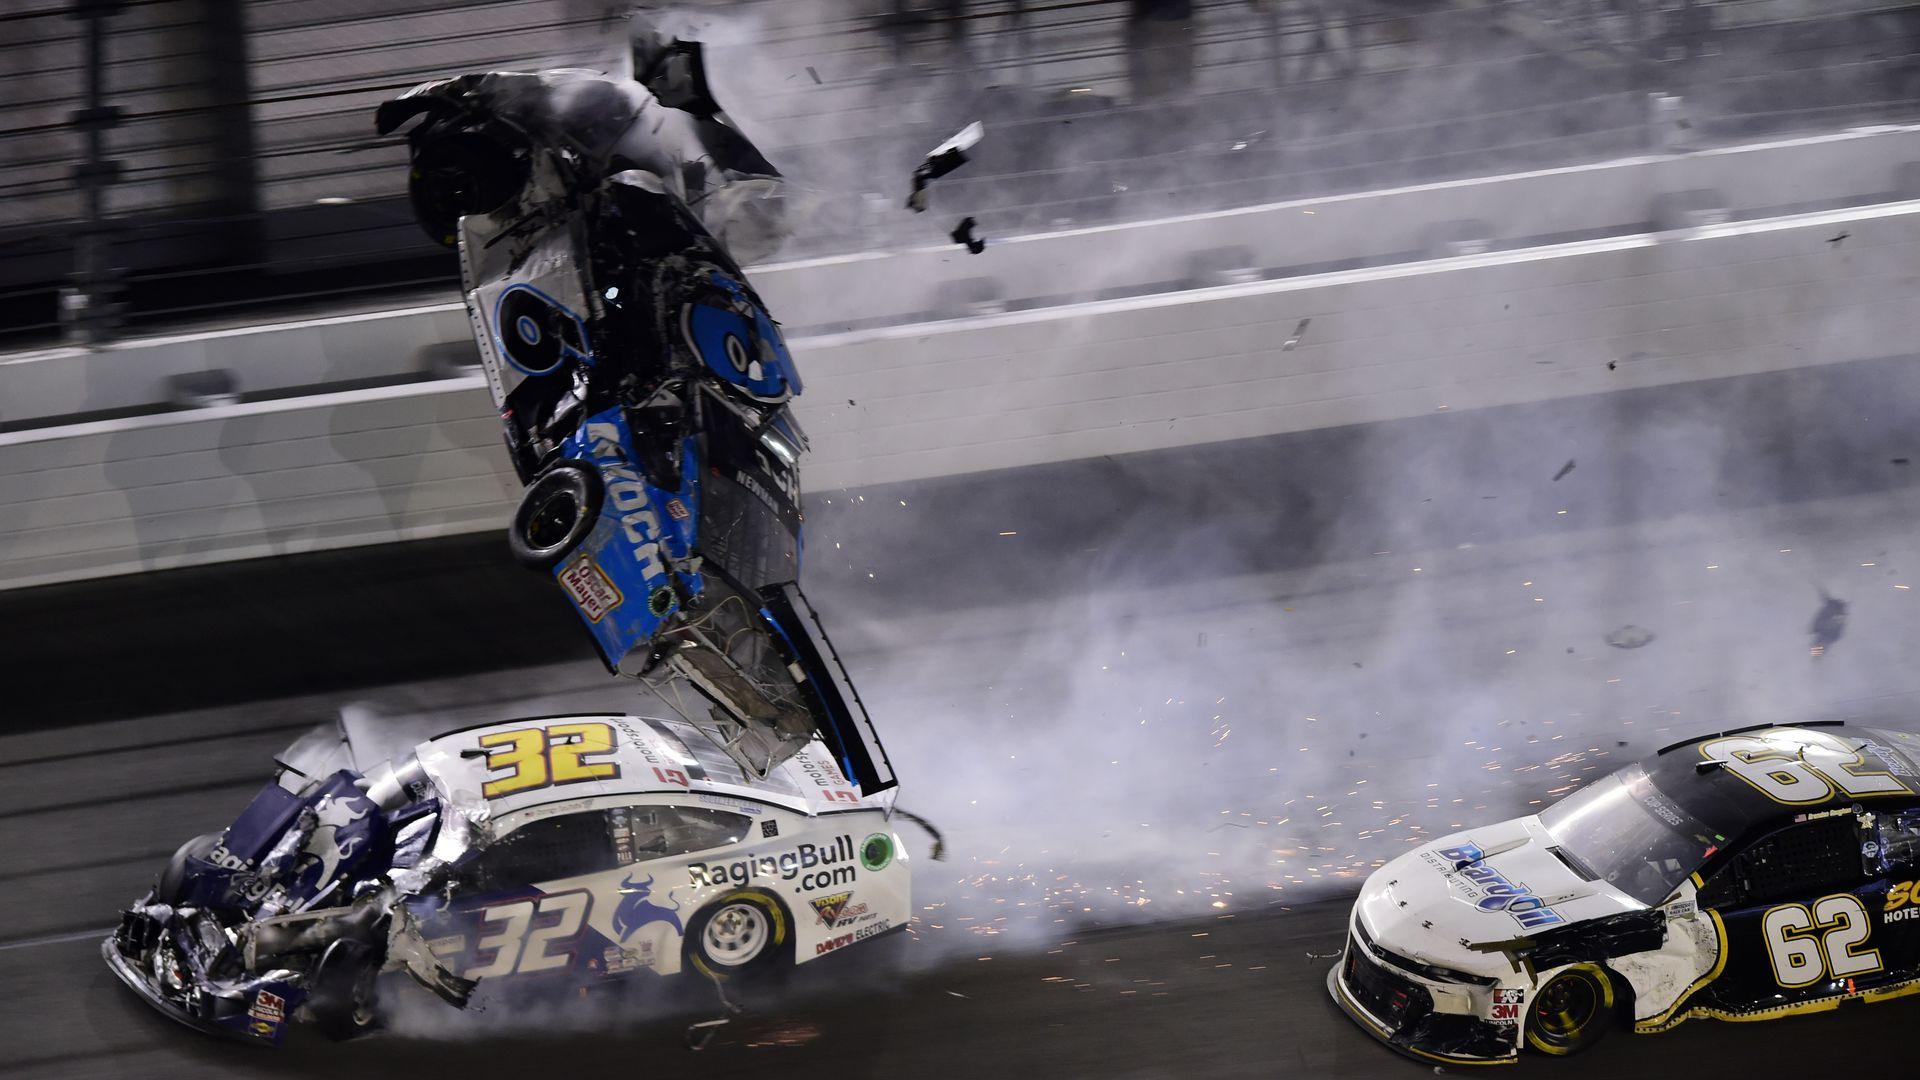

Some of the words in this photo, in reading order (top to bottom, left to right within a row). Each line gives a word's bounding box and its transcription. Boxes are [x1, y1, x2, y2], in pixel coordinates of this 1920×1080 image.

[567, 571, 601, 612] Mayer
[579, 566, 612, 601] Oscar
[479, 722, 621, 799] 32
[818, 760, 845, 786] GAMES
[1699, 727, 1914, 805] 62
[687, 834, 855, 888] RagingBull
[794, 865, 856, 893] .com
[1420, 852, 1478, 898] DISTRIBUTING
[1432, 840, 1532, 896] Beard
[464, 889, 595, 981] 32
[856, 919, 889, 939] ELECTRIC
[1761, 893, 1884, 988] 62
[258, 992, 284, 1008] 3M
[1492, 1005, 1519, 1018] 3M
